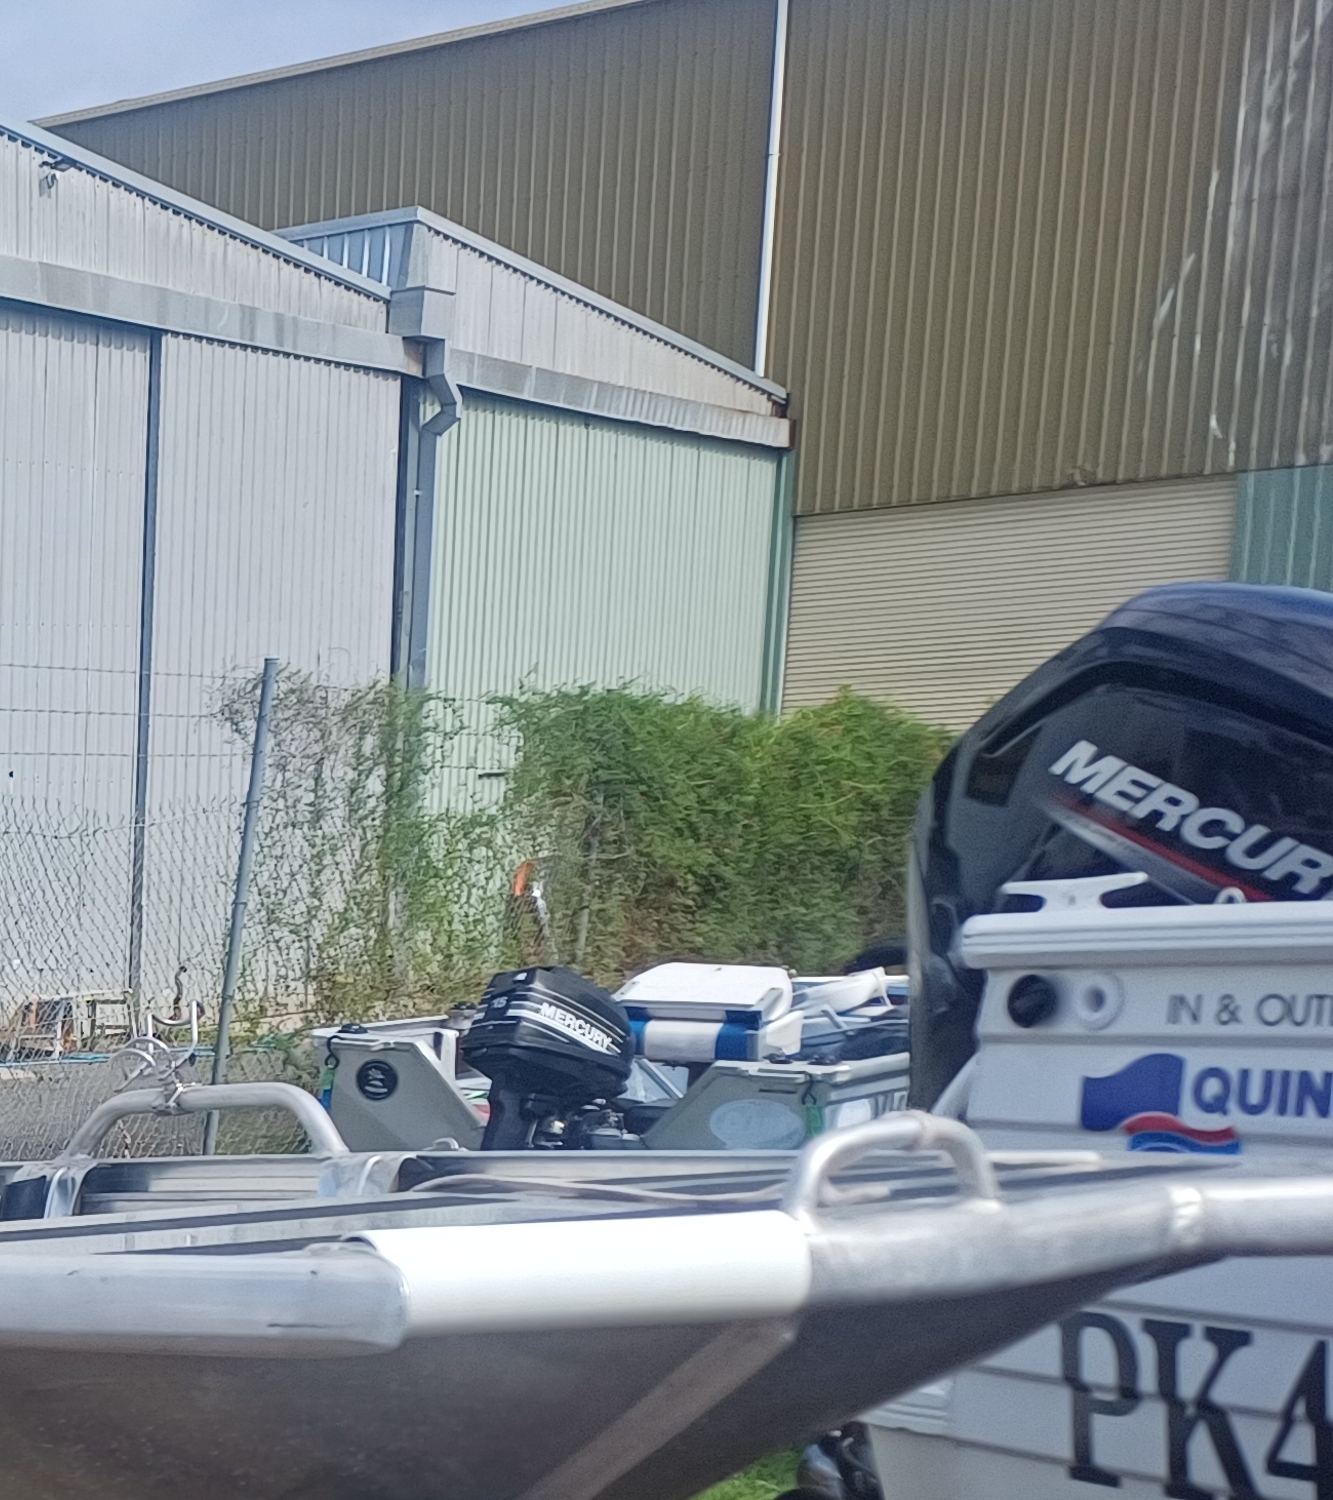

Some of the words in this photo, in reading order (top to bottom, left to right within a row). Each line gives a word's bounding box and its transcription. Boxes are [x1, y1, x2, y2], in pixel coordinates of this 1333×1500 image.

[1047, 740, 1333, 900] MERCUR
[540, 1002, 612, 1051] MERCURY
[1166, 993, 1203, 1026] IN
[1216, 993, 1244, 1026] &
[1257, 993, 1333, 1027] OUT
[1192, 1066, 1333, 1118] QUIN
